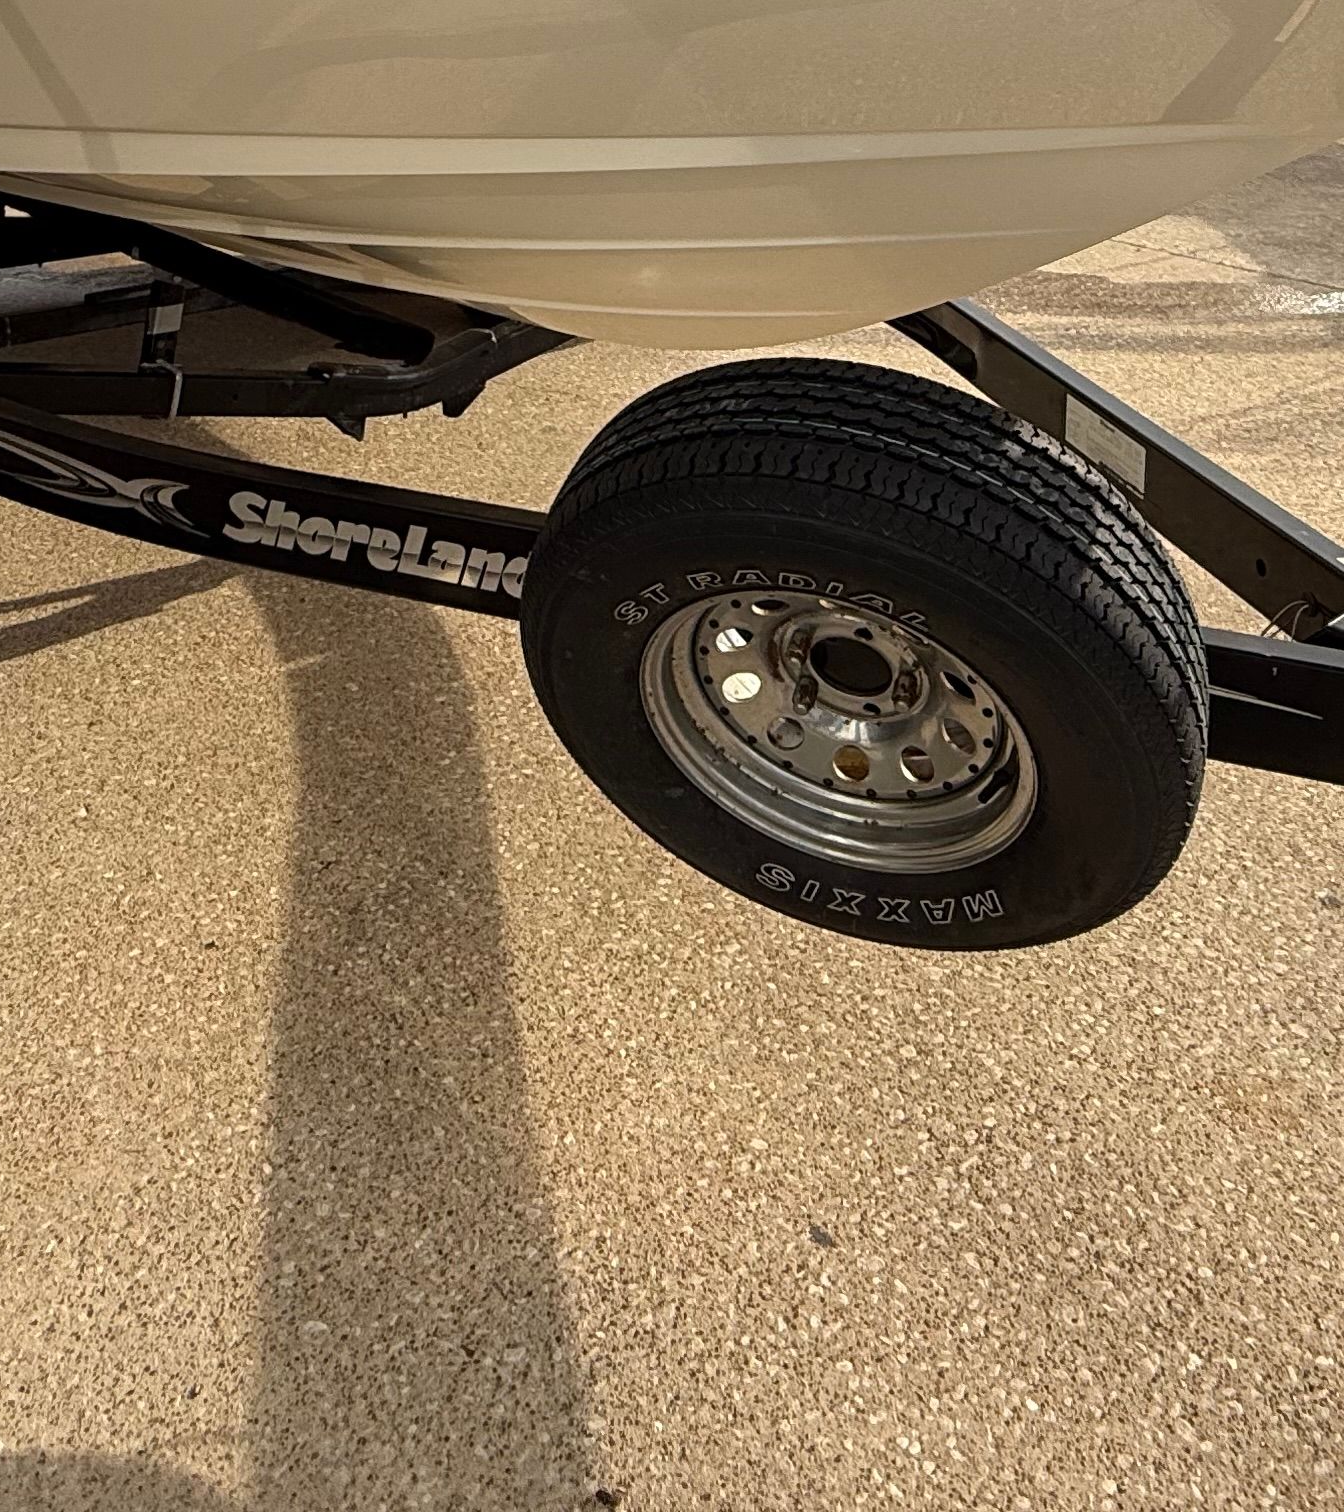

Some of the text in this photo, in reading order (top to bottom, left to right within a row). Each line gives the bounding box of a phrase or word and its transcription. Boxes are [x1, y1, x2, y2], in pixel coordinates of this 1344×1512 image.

[614, 569, 930, 633] ST RADIAL
[755, 862, 1004, 925] MAXXIS
